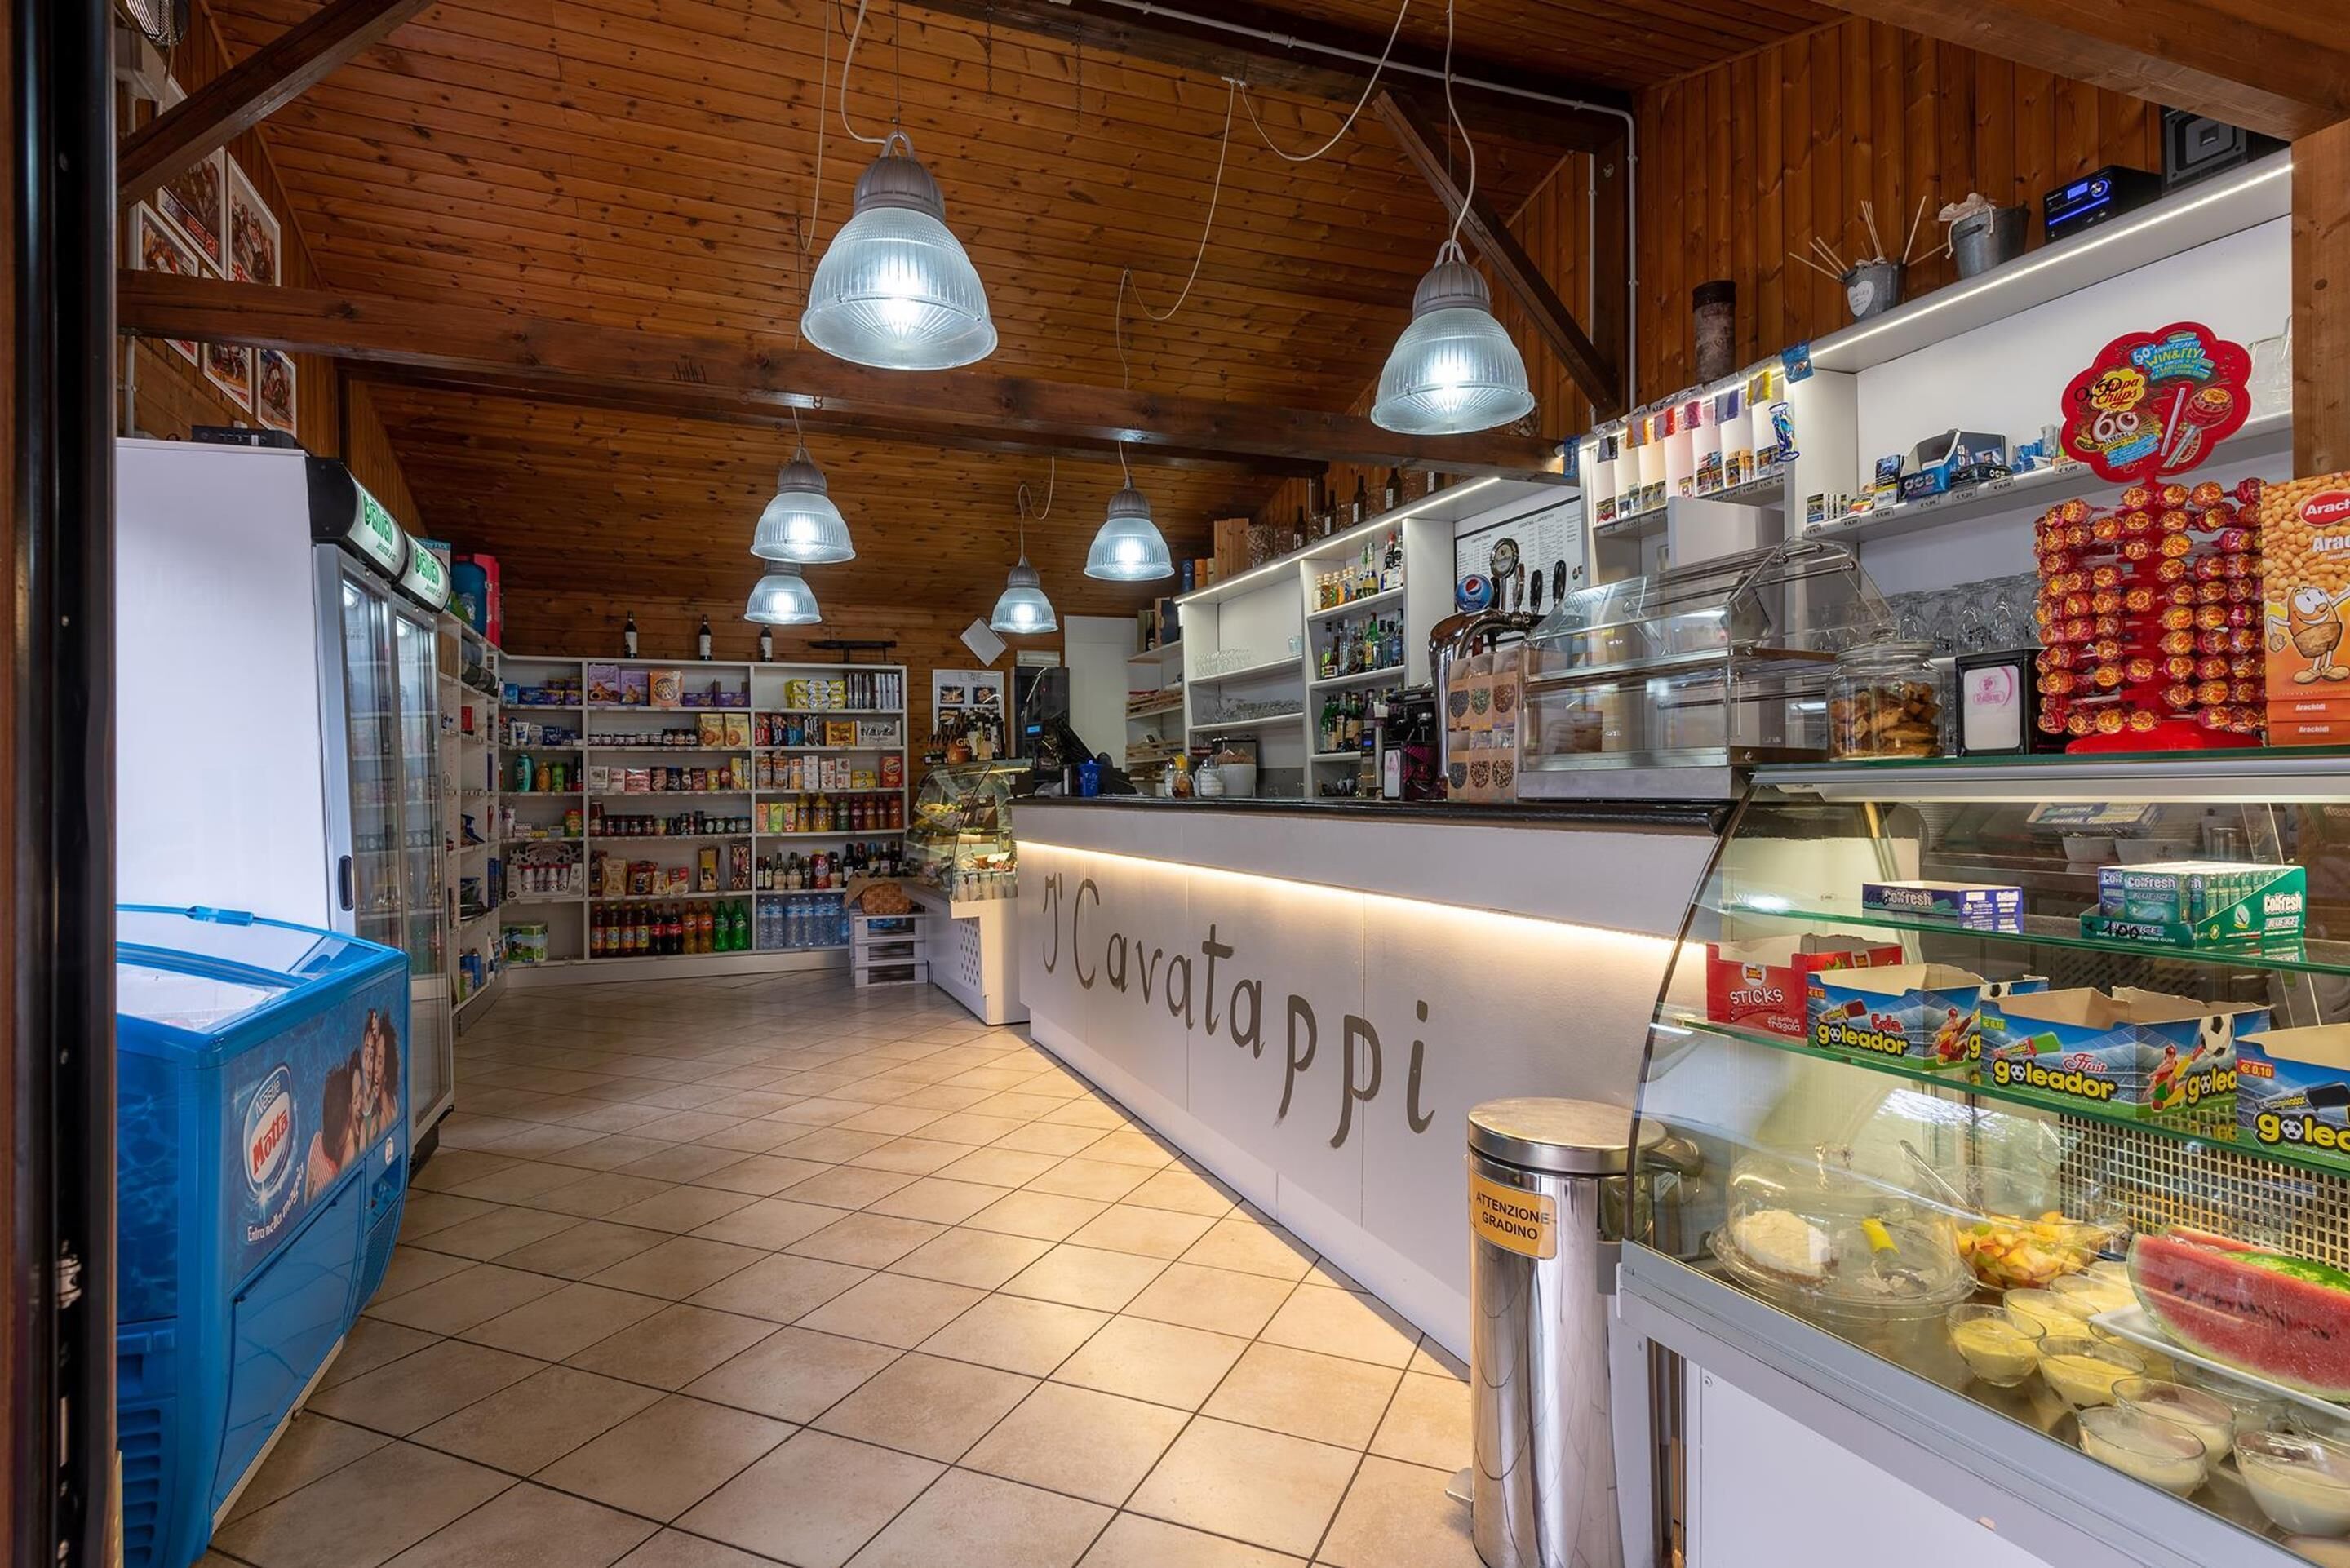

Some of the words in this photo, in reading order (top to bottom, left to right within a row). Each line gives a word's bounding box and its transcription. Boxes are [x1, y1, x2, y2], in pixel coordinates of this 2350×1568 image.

[2295, 702, 2326, 711] Arachidi
[2299, 724, 2330, 733] Arachidi
[1729, 986, 1785, 1006] STICKS
[1073, 877, 1435, 1148] Cavatappi
[1817, 1022, 1909, 1056] goleador
[1993, 1060, 2117, 1100] goleador
[2241, 1063, 2250, 1074] €
[2251, 1065, 2272, 1078] 0,10
[252, 1109, 289, 1176] Motta
[1475, 1190, 1550, 1225] ATTENZIONE
[1481, 1211, 1538, 1240] GRADINO
